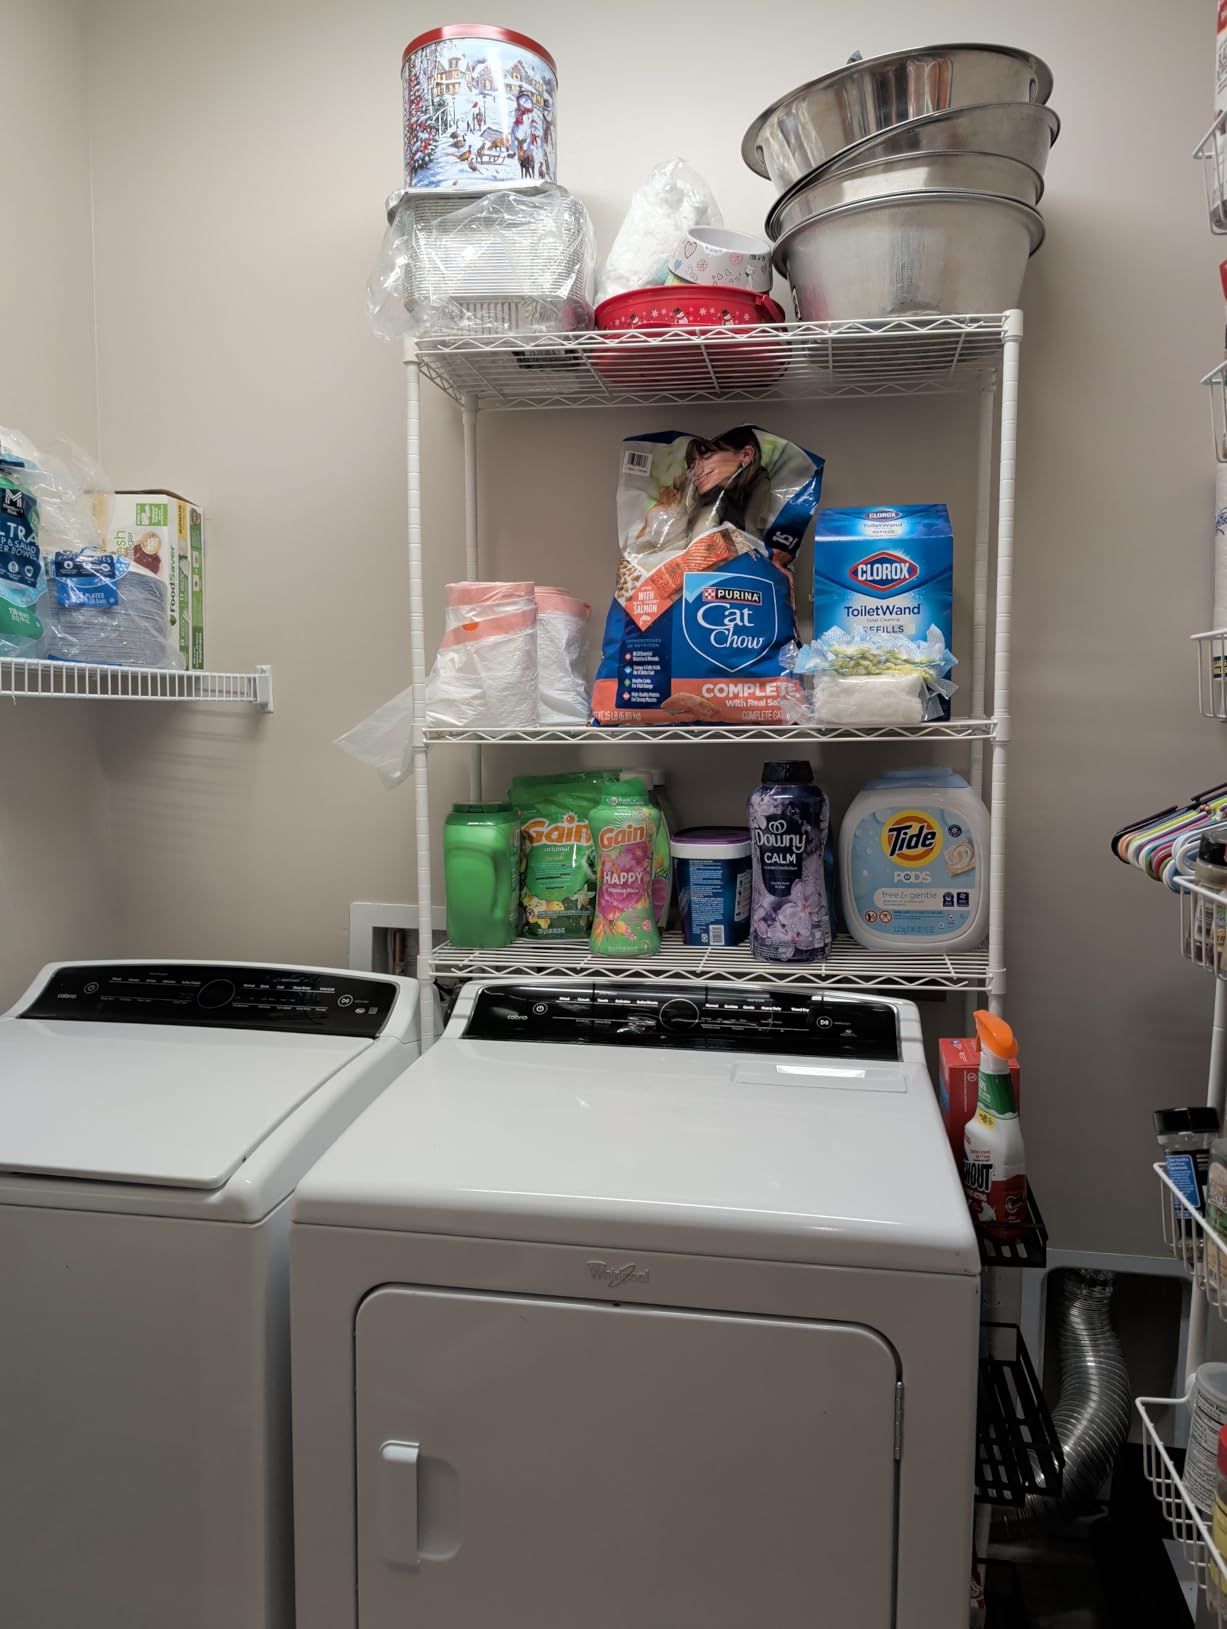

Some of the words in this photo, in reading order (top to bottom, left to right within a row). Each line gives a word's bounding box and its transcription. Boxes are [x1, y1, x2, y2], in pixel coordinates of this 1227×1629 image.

[114, 530, 126, 557] esh
[857, 562, 910, 581] CLOROX
[638, 591, 655, 600] WITH
[717, 589, 760, 602] PURINA
[633, 603, 659, 614] SALMON
[697, 602, 755, 629] Cat
[843, 604, 921, 617] ToiletWand
[710, 624, 764, 649] Chow
[748, 699, 766, 707] Real
[522, 812, 593, 846] Gain
[599, 814, 646, 851] Gain
[755, 829, 806, 853] Downy
[887, 824, 937, 857] Tide
[764, 852, 797, 864] CALM
[603, 871, 643, 885] HAPPY
[894, 871, 931, 883] PODS
[881, 891, 899, 899] free
[909, 891, 937, 900] gentle
[964, 1163, 992, 1191] HOUT
